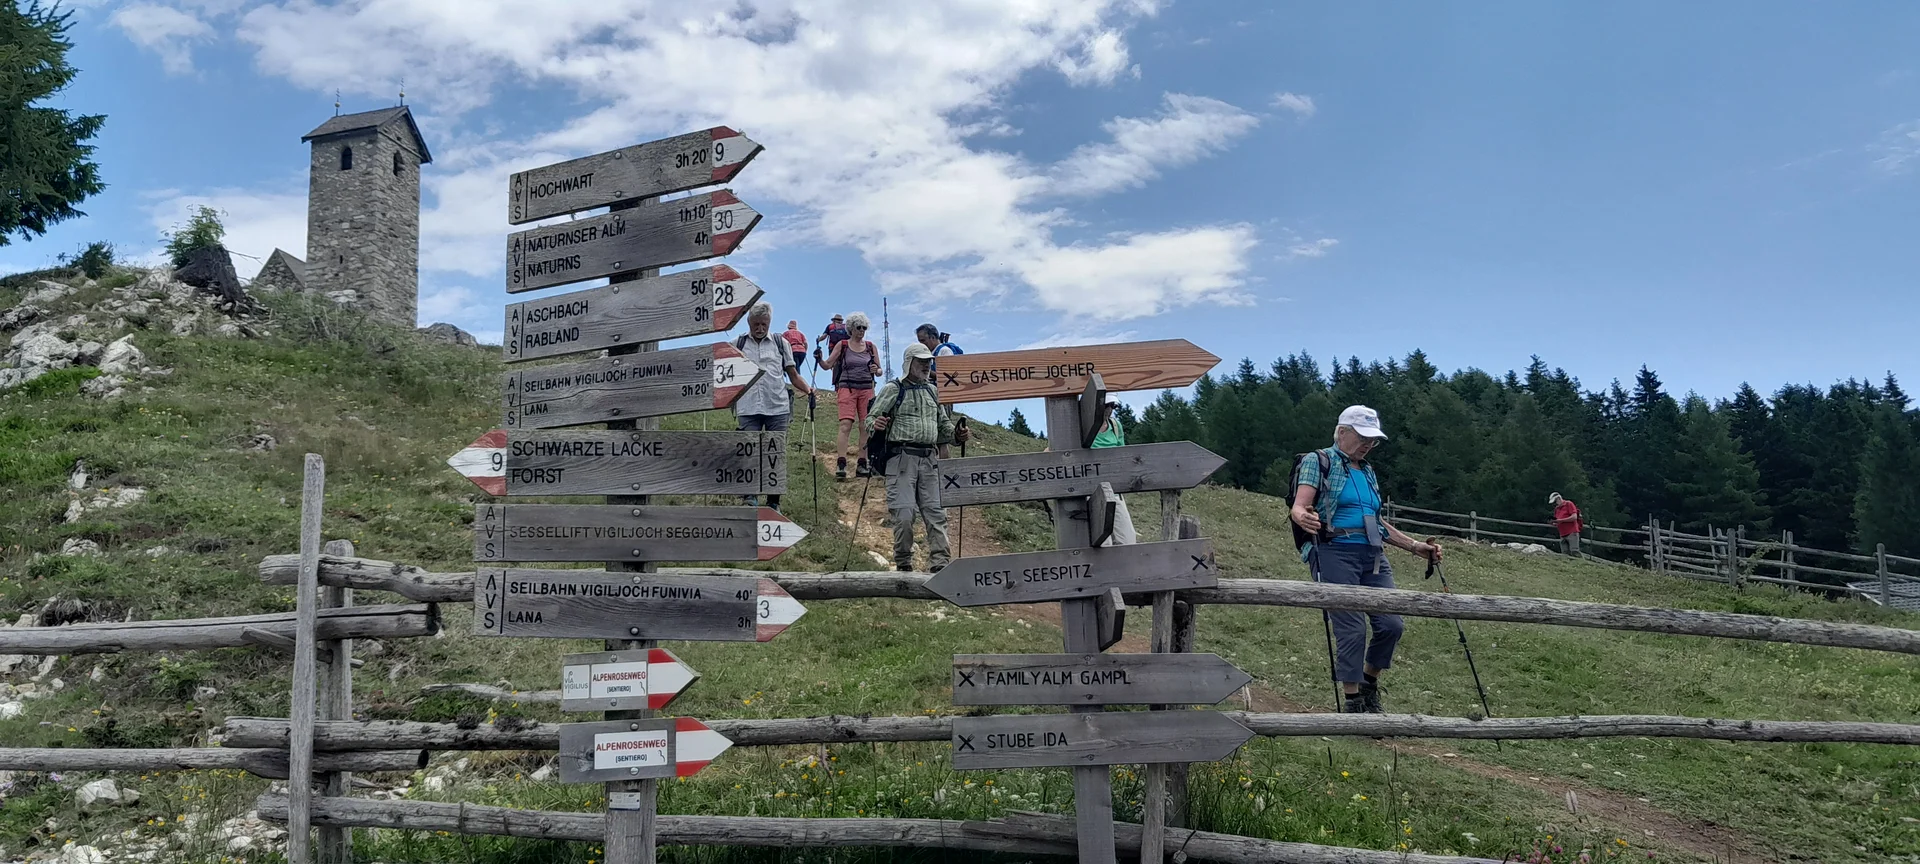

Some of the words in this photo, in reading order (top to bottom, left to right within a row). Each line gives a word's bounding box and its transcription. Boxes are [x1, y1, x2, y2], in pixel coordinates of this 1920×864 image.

[715, 142, 725, 162] 9
[530, 173, 594, 200] HOCHWART
[675, 153, 690, 169] 3h
[692, 148, 710, 166] 20'
[714, 209, 733, 231] 30
[528, 226, 597, 252] NATURNSER
[601, 220, 626, 239] ALM
[528, 255, 581, 277] NATURNS
[694, 231, 709, 246] 4h
[526, 300, 589, 324] ASCHBACH
[691, 278, 709, 296] 50'
[714, 284, 734, 306] 28
[525, 326, 580, 348] RABLAND
[694, 306, 709, 322] 3h
[524, 376, 571, 393] SEILBAHN
[575, 369, 627, 386] VIGILJOCH
[632, 363, 673, 379] FUNIVIA
[695, 358, 710, 371] 50'
[716, 363, 735, 384] 34
[970, 366, 1036, 384] GASTHOF
[1044, 362, 1095, 380] JOCHER
[524, 403, 549, 416] LANA
[681, 385, 694, 397] 3h
[695, 383, 710, 395] 20'
[512, 440, 604, 457] SCHWARZE
[612, 441, 663, 457] LACKE
[736, 442, 757, 457] 20'
[491, 451, 503, 472] 9
[511, 468, 565, 484] FORST
[715, 469, 733, 483] 3h
[736, 469, 757, 483] 20'
[971, 470, 1012, 486] REST.
[1019, 463, 1102, 482] SESSELLIFT
[510, 526, 590, 539] SESSELLIFT
[594, 526, 662, 539] VIGILJOCH
[667, 526, 734, 539] SEGGIOVIA
[761, 523, 782, 542] 34
[1023, 564, 1092, 583] SEESPITZ
[510, 581, 577, 597] SEILBAHN
[581, 583, 649, 598] VIGILJOCH
[652, 586, 702, 600] FUNIVIA
[735, 589, 753, 601] 40'
[508, 610, 543, 624] LANA
[737, 616, 751, 629] 3h
[759, 600, 770, 619] 3
[564, 682, 589, 690] VIGILIUS
[592, 671, 647, 682] ALPENROSENWEG
[986, 671, 1072, 686] FAMILYALM
[1080, 670, 1131, 685] GAMPL
[596, 739, 667, 751] ALPENROSENWEG
[987, 733, 1035, 748] STUBE
[1043, 732, 1068, 747] IDA
